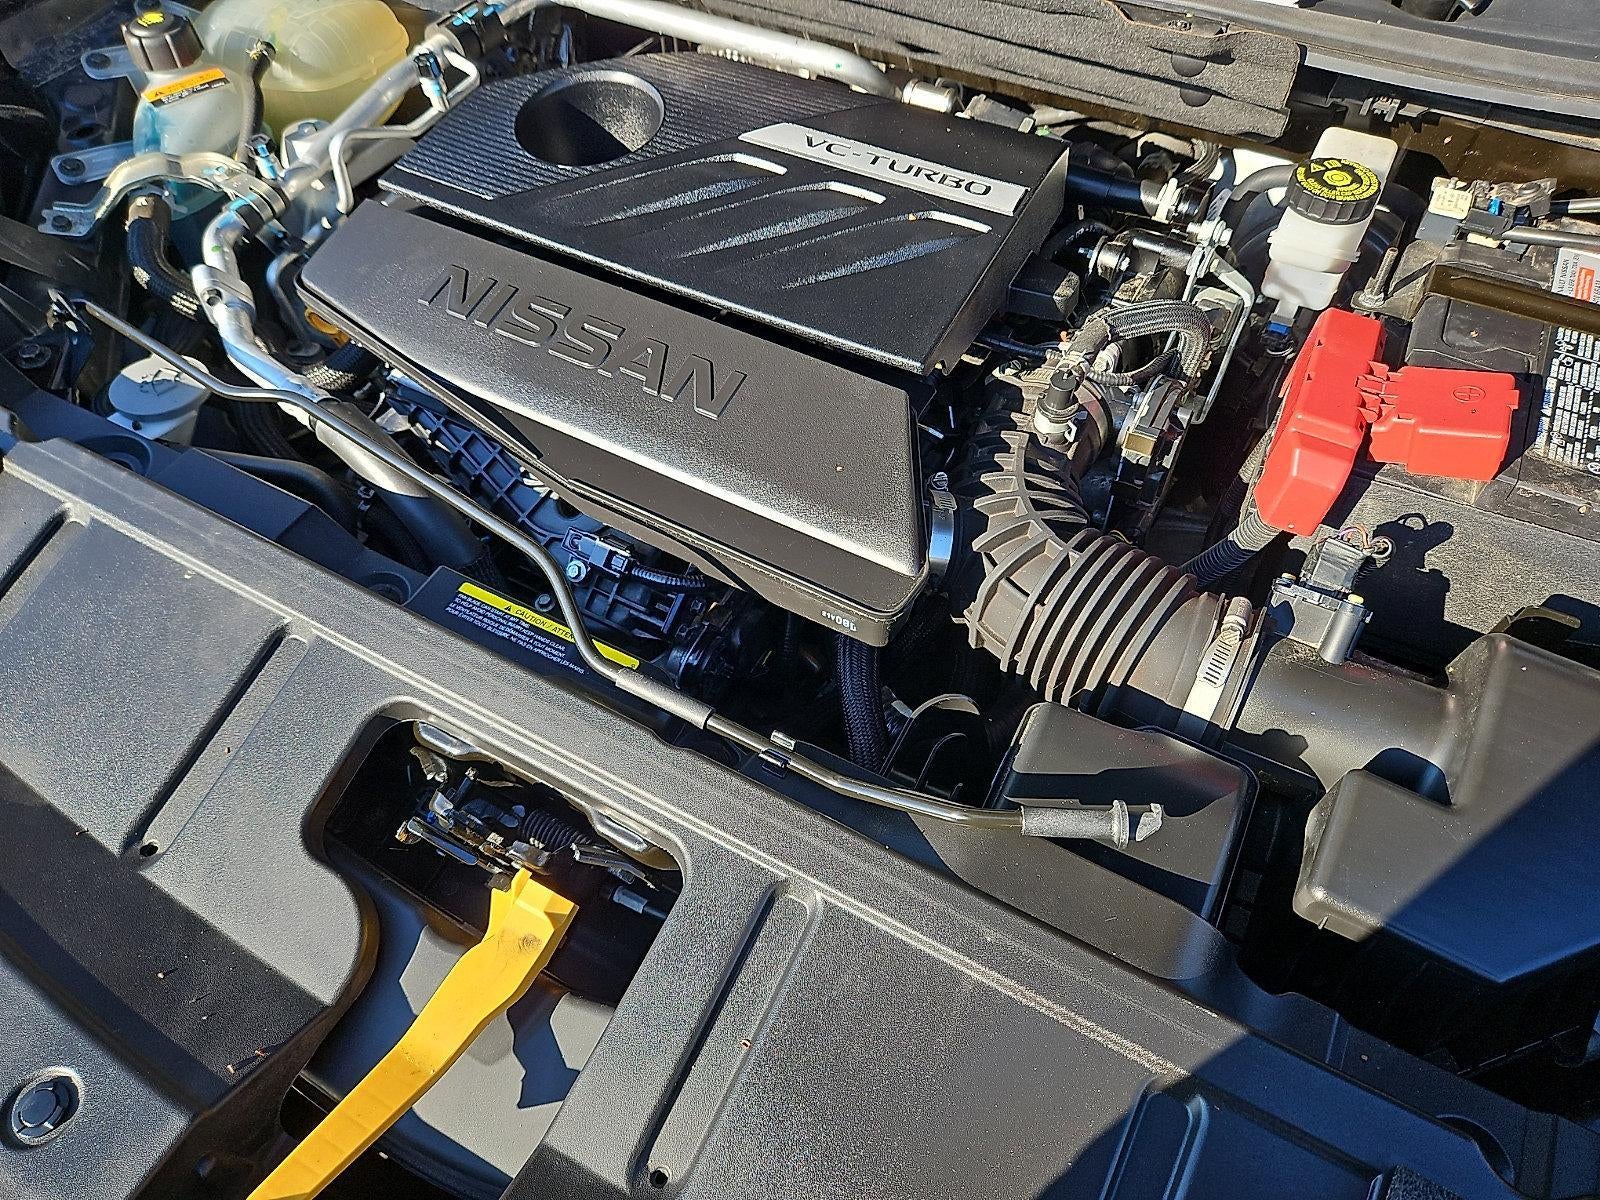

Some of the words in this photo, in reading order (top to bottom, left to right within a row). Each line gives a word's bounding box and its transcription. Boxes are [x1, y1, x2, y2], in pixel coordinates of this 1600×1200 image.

[804, 132, 992, 197] VC-TURBO
[417, 264, 748, 421] NISSAN
[515, 608, 547, 629] CAUTION
